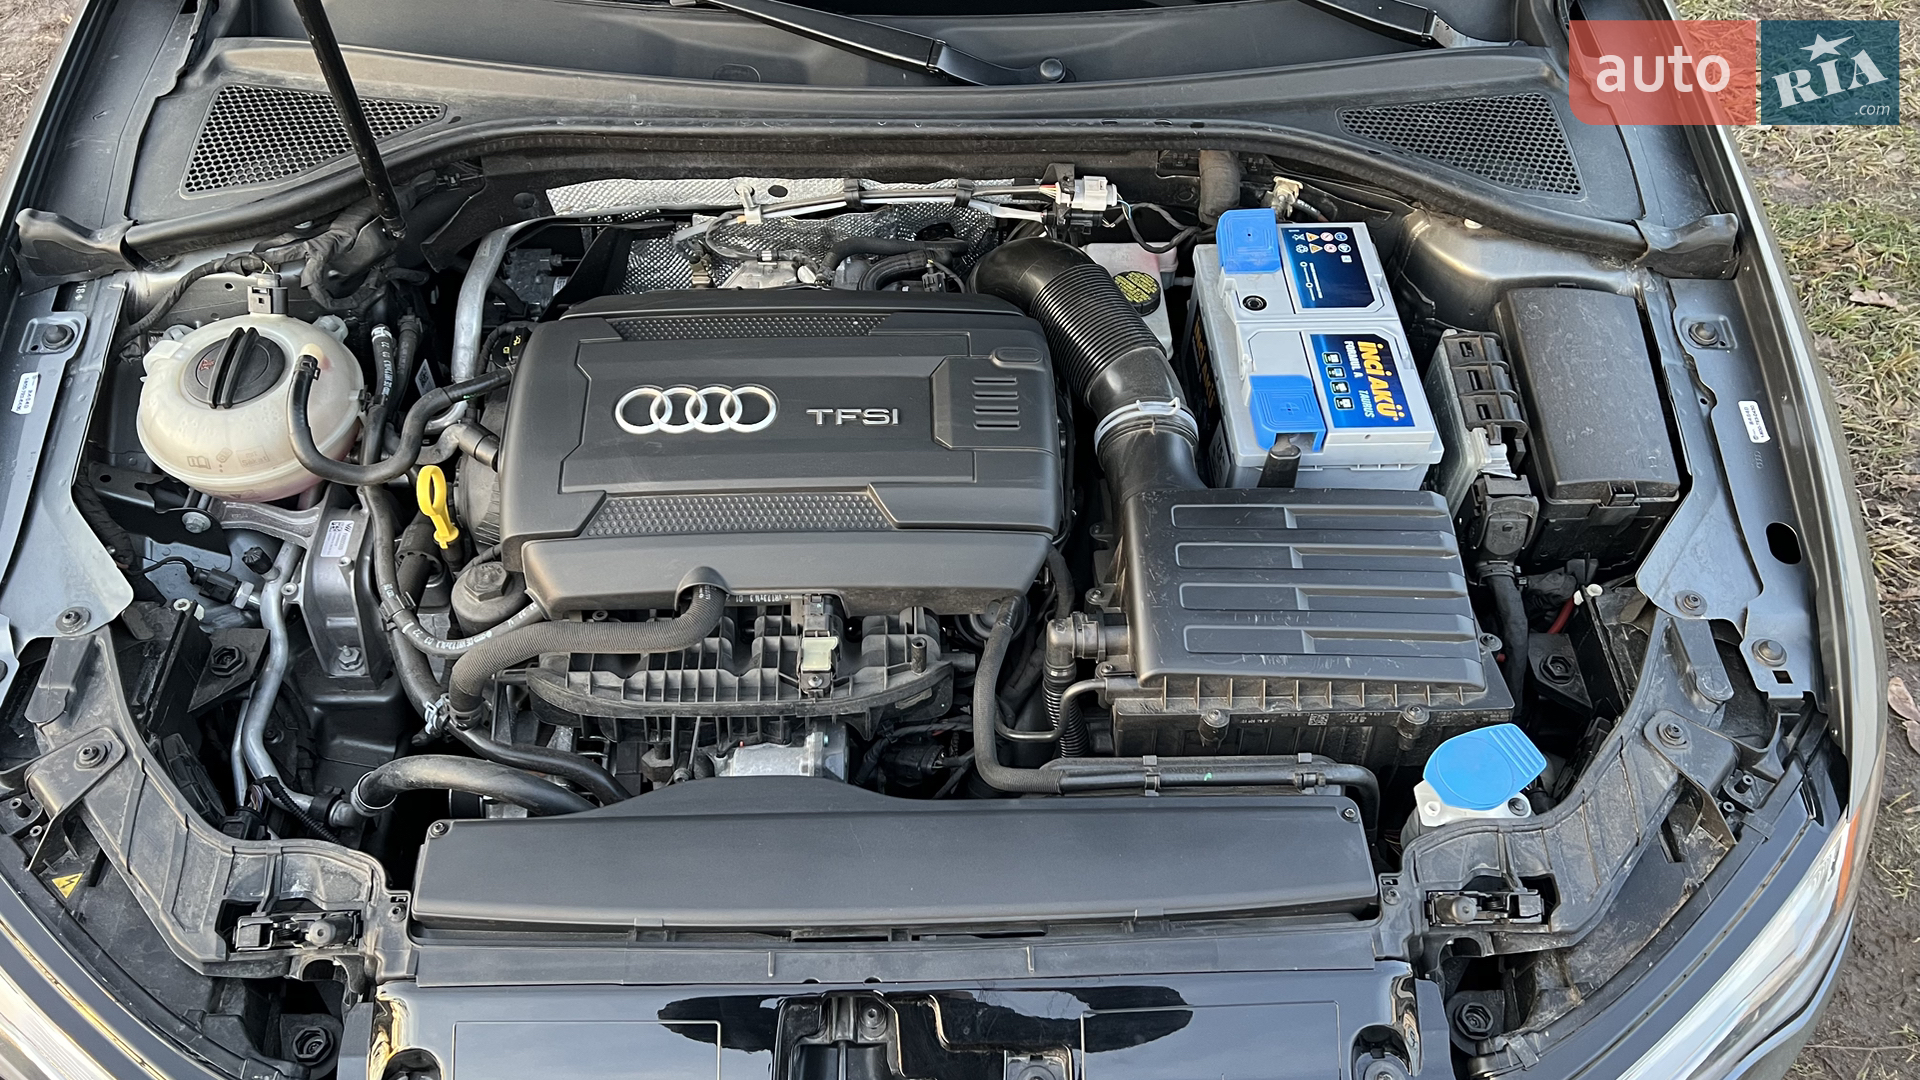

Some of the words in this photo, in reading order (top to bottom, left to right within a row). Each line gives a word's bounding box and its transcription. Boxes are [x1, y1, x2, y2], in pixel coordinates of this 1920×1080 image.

[1358, 390, 1375, 418] TAURUS
[1368, 375, 1405, 418] AKÜ
[806, 408, 899, 426] TFSI
